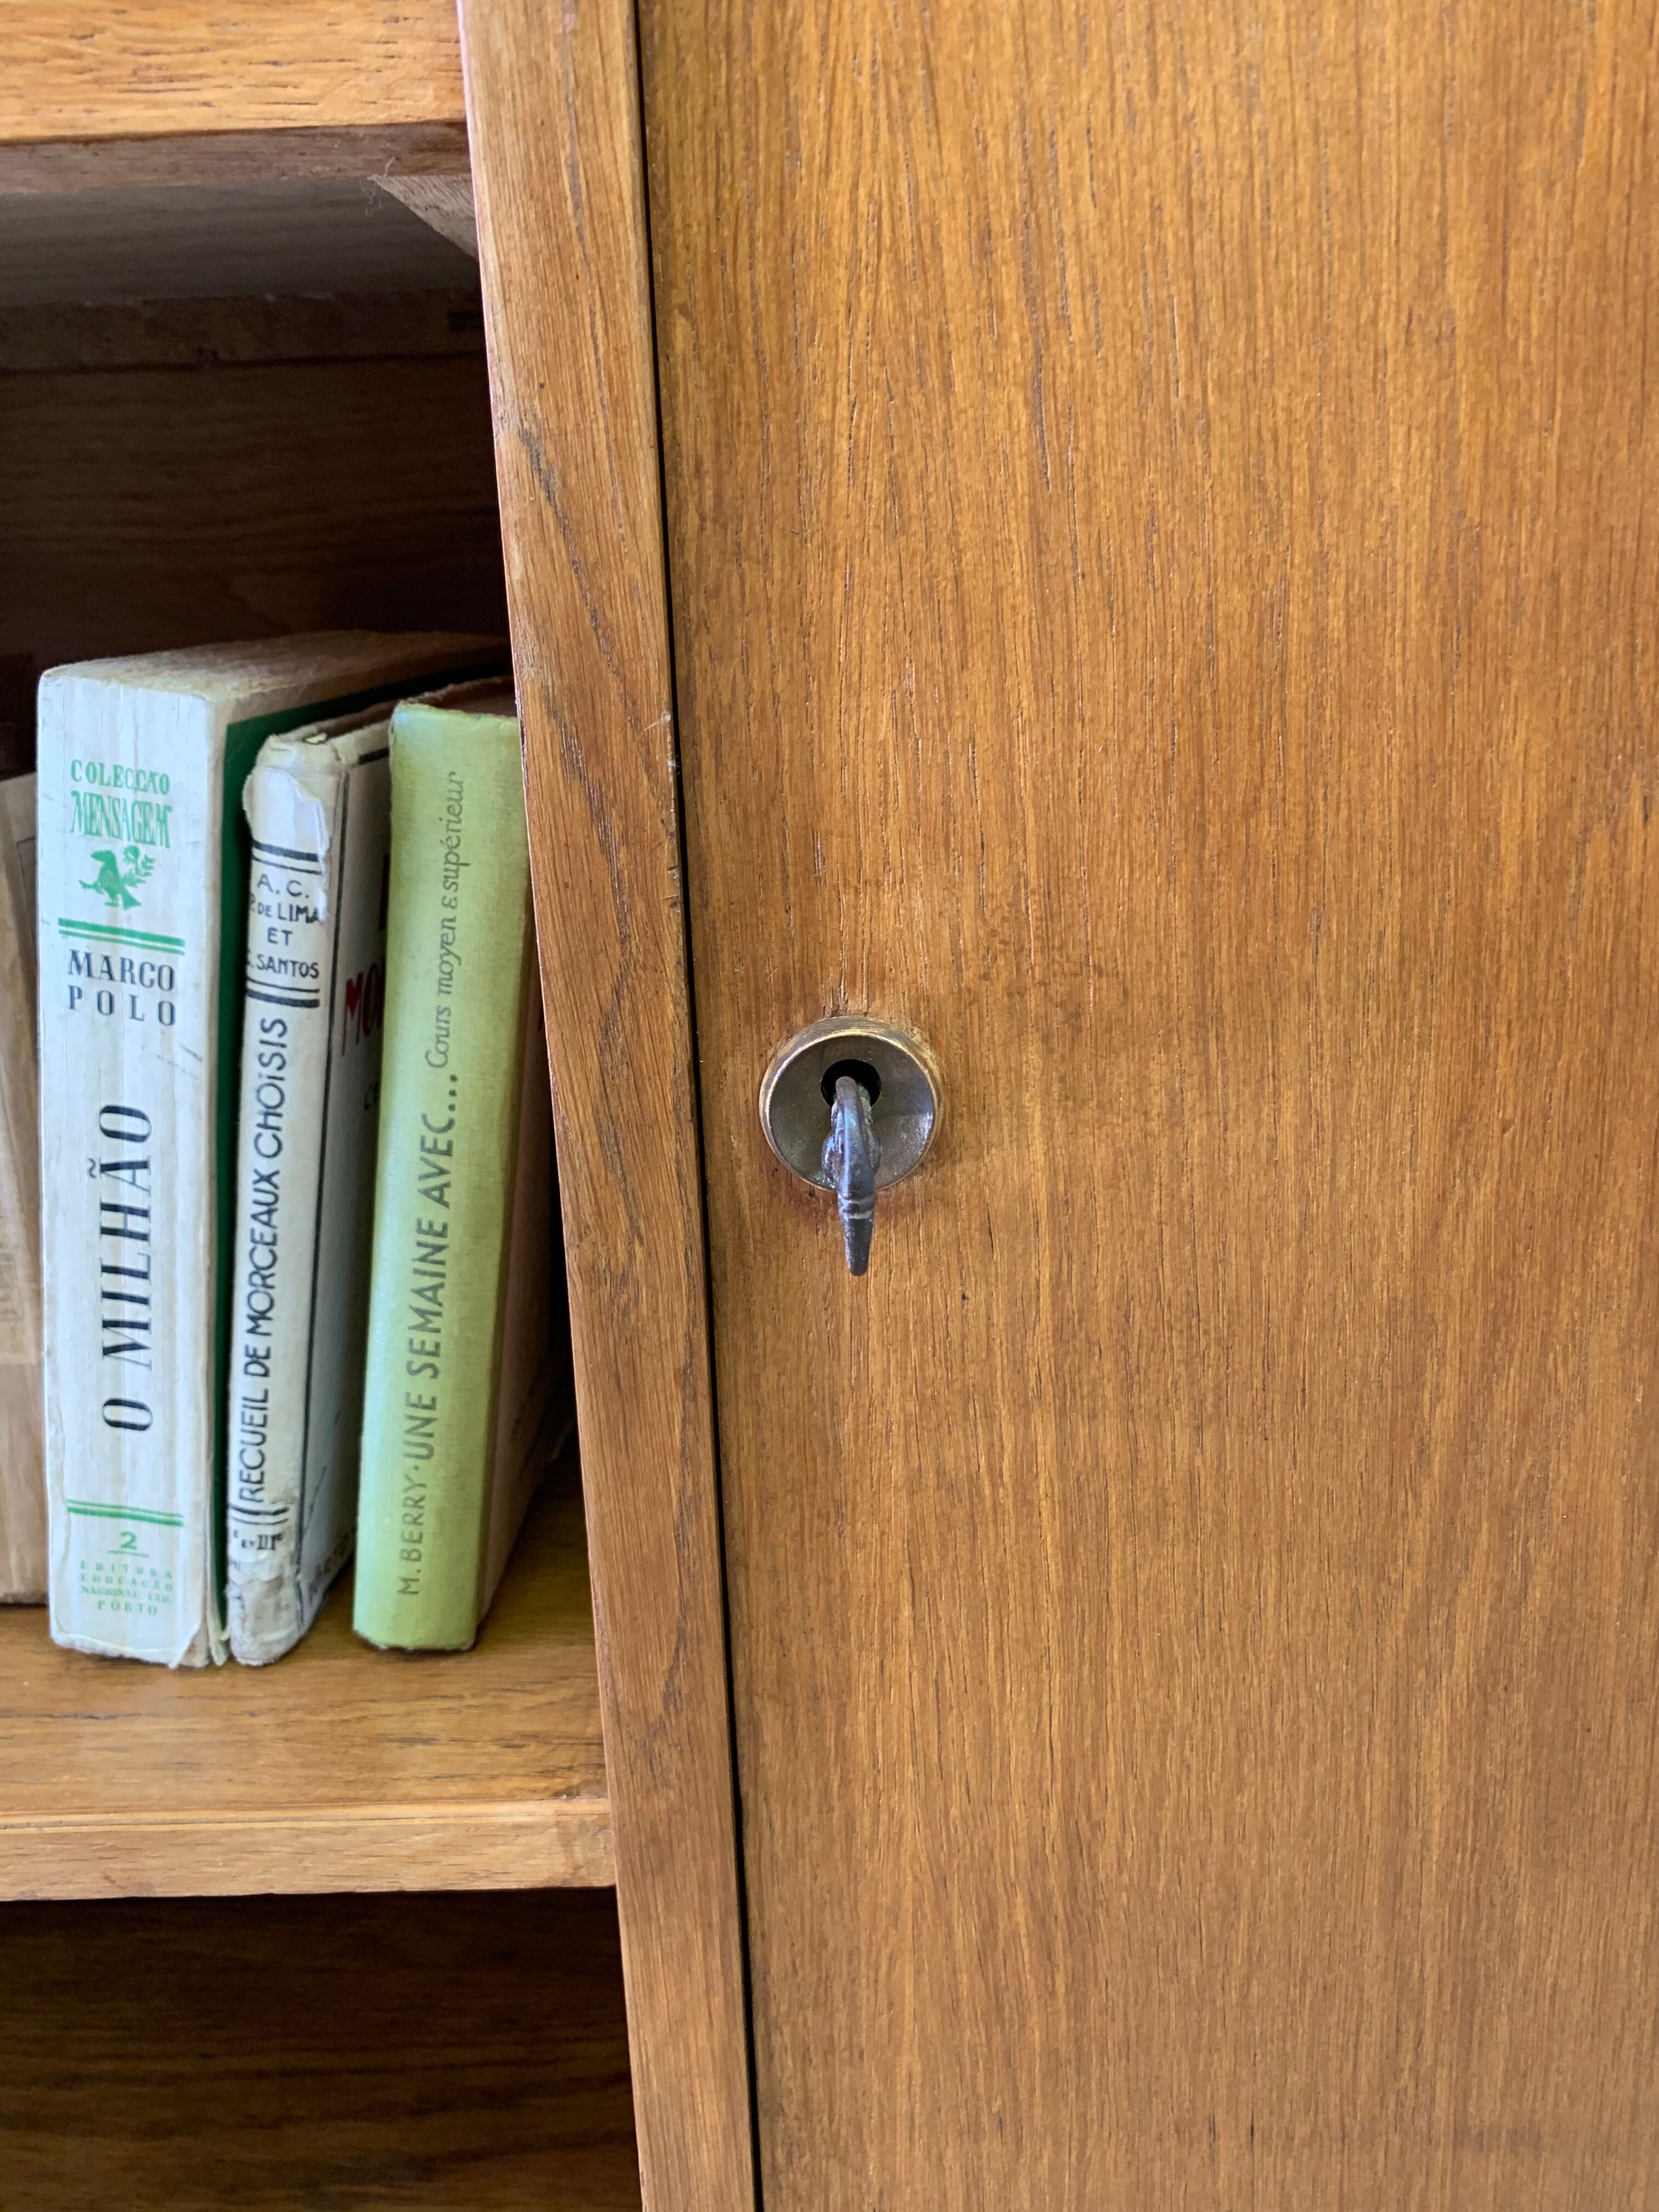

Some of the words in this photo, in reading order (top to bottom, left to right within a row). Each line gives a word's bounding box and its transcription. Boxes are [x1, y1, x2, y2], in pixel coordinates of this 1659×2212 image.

[70, 790, 173, 849] MENSAGEM
[438, 771, 471, 893] supérieur
[257, 902, 272, 918] DE
[278, 902, 320, 924] LIMA
[267, 927, 294, 946] ET
[69, 949, 176, 992] MARCO
[257, 953, 320, 979] SANTOS
[437, 916, 462, 996] moyen
[69, 984, 176, 1027] POLO
[425, 1005, 452, 1069] Cours
[89, 1104, 152, 1372] MILHÃO
[247, 1169, 280, 1336] MORCEAUX
[407, 1217, 450, 1380] SEMAINE
[244, 1343, 272, 1378] DE
[103, 1398, 153, 1431] O
[239, 1388, 269, 1503] RECUEIL
[120, 1530, 137, 1550] 2
